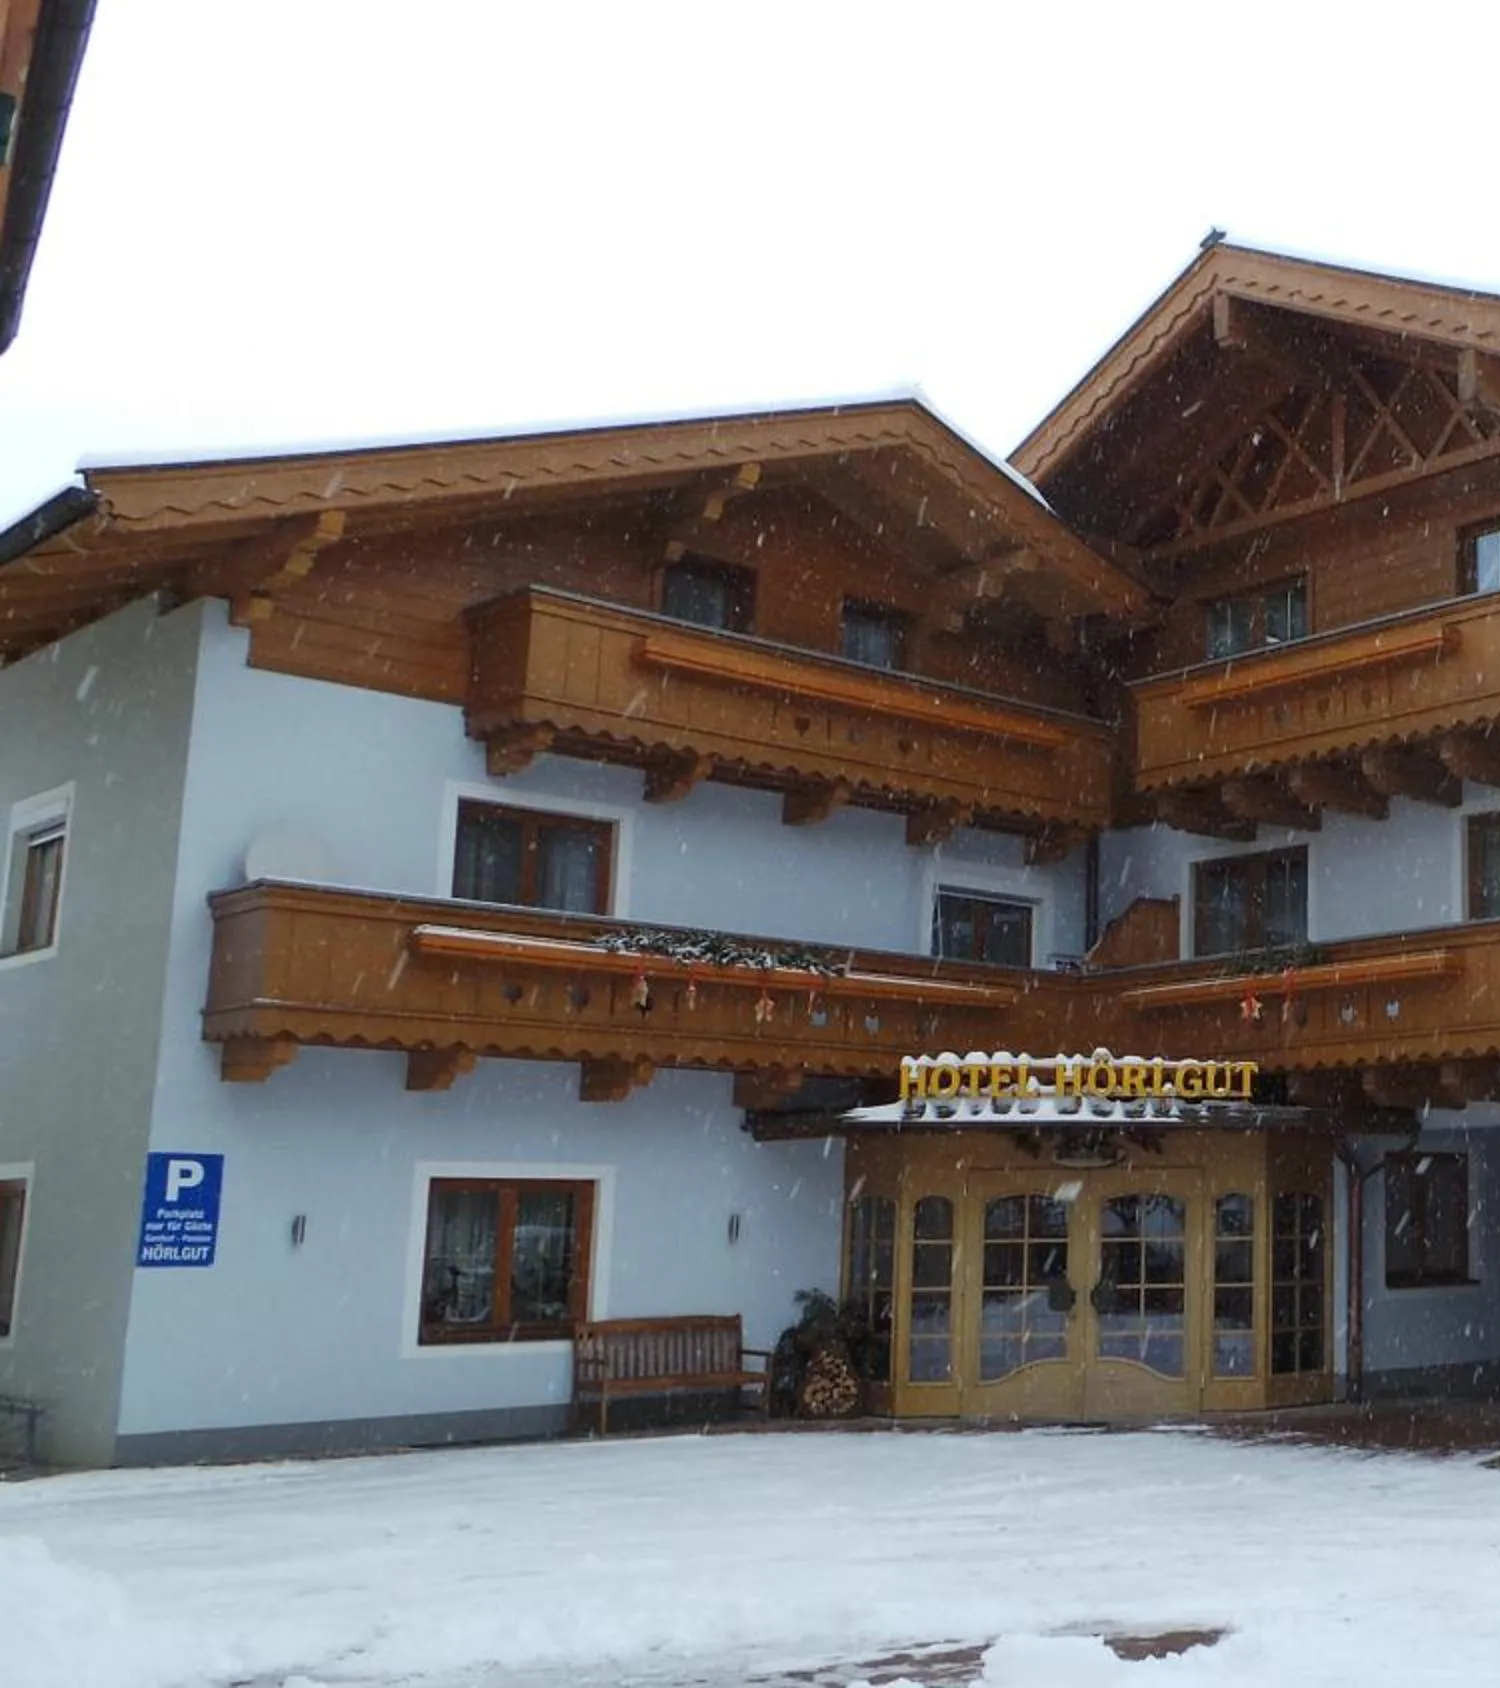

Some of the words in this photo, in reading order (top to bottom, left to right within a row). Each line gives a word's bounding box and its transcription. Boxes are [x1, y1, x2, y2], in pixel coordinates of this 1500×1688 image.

[900, 1061, 1031, 1098] HOTEL
[1055, 1053, 1258, 1098] HÖRLGUT
[165, 1159, 205, 1202] P
[157, 1208, 204, 1220] Parkplatz
[145, 1222, 164, 1231] nur
[167, 1221, 182, 1231] für
[184, 1221, 213, 1231] Gäste
[142, 1244, 210, 1261] HÖRLGUT
